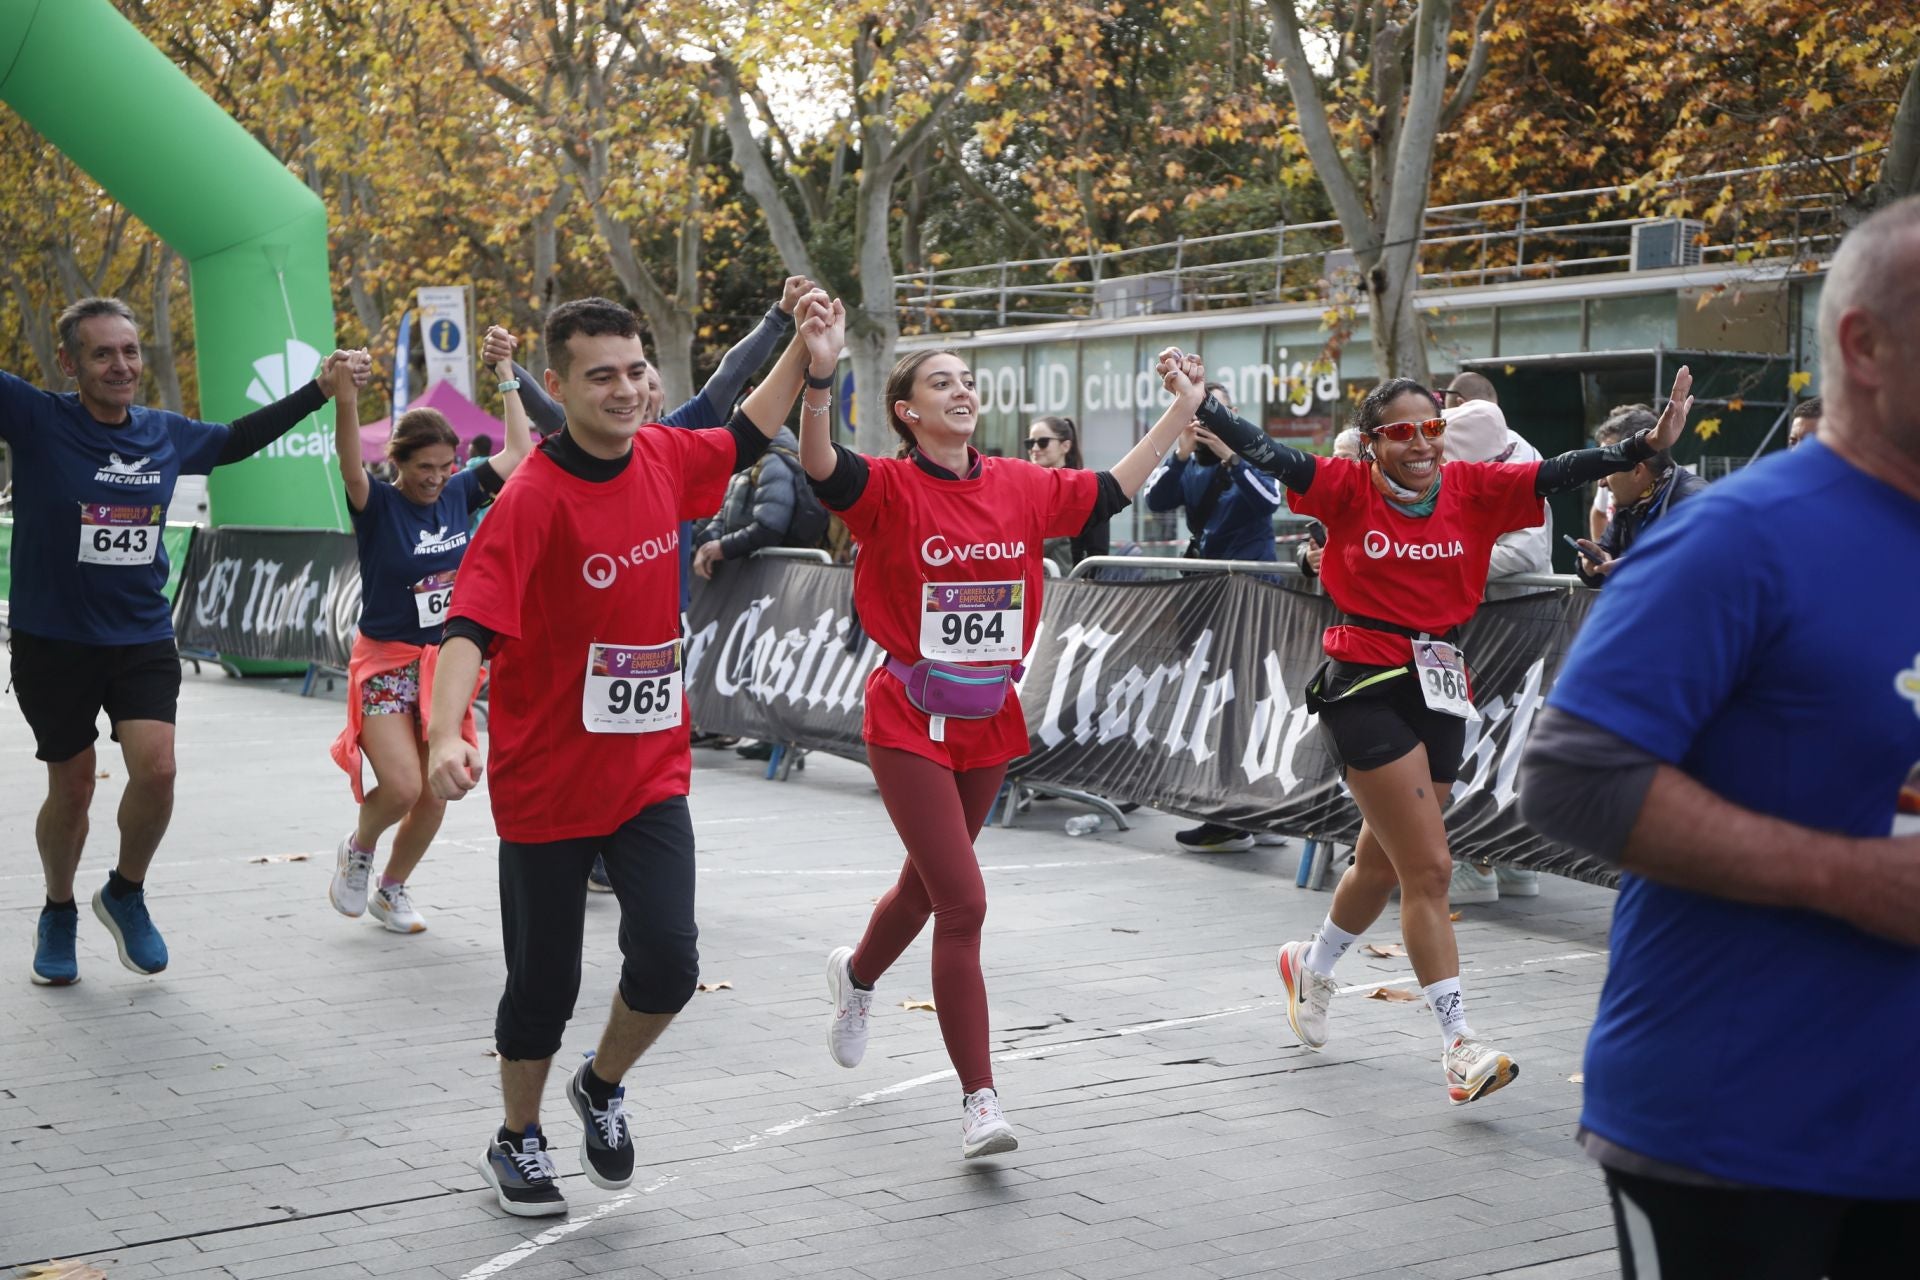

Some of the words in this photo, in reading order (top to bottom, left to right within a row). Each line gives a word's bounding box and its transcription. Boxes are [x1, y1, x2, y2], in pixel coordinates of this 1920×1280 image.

[1216, 347, 1340, 417] amiga
[252, 424, 336, 465] icaj
[94, 471, 161, 485] MICHELIN
[93, 528, 148, 553] 643
[414, 534, 467, 555] MICHELIN
[953, 541, 1025, 561] VEOLIA
[1393, 540, 1464, 560] VEOLIA
[941, 612, 1005, 646] 964
[715, 594, 884, 714] Castill
[607, 677, 671, 715] 965
[1426, 668, 1468, 702] 966
[1038, 622, 1235, 766] Norte
[1241, 650, 1320, 796] de
